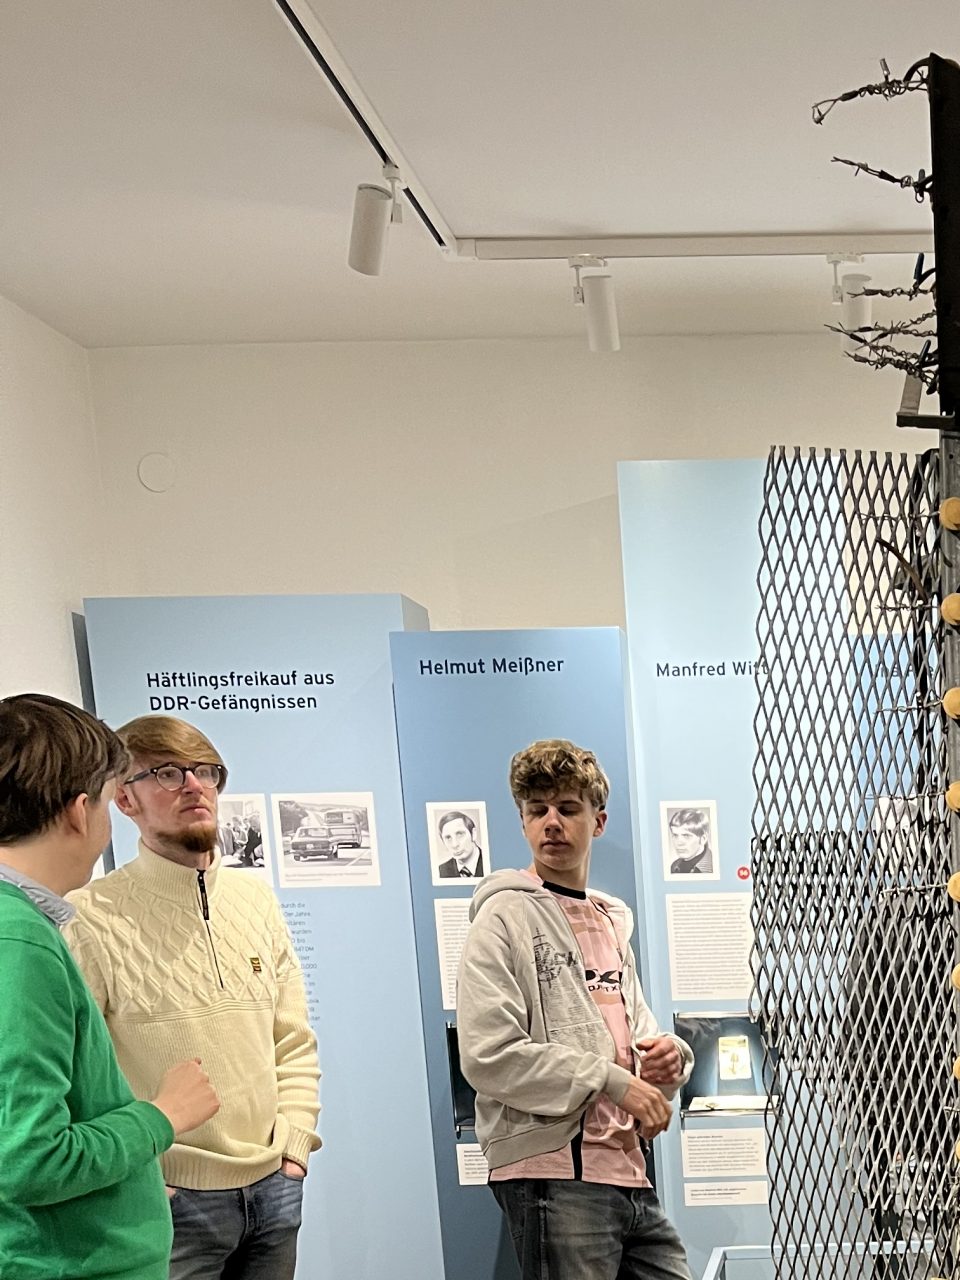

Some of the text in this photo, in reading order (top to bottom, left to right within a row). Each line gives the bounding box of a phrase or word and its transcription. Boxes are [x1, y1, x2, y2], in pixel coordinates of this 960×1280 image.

[419, 657, 564, 676] Helmut Meißner
[656, 661, 726, 677] Manfred
[146, 670, 335, 690] Häftlingsfreikauf aus
[149, 694, 318, 712] DDR-Gefängnissen
